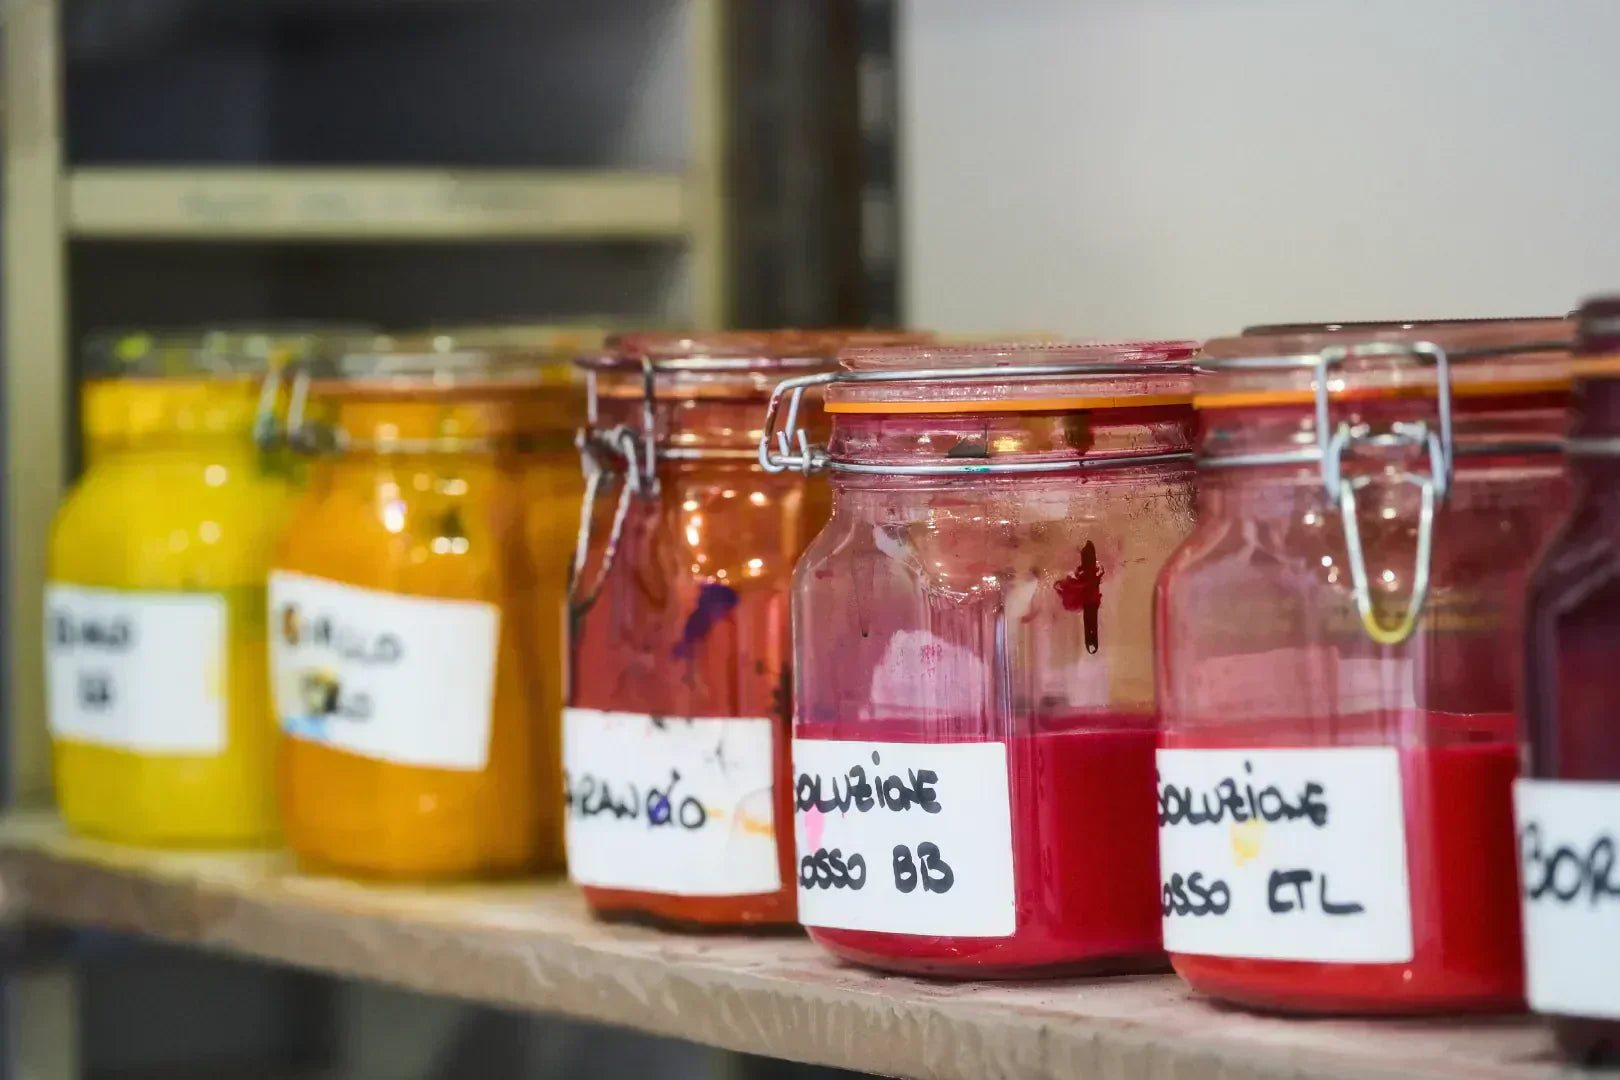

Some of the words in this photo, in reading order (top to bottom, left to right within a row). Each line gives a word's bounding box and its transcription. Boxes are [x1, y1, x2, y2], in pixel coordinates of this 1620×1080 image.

[799, 848, 867, 891] OSSO
[892, 841, 955, 894] BB
[1161, 872, 1231, 918] OSSO
